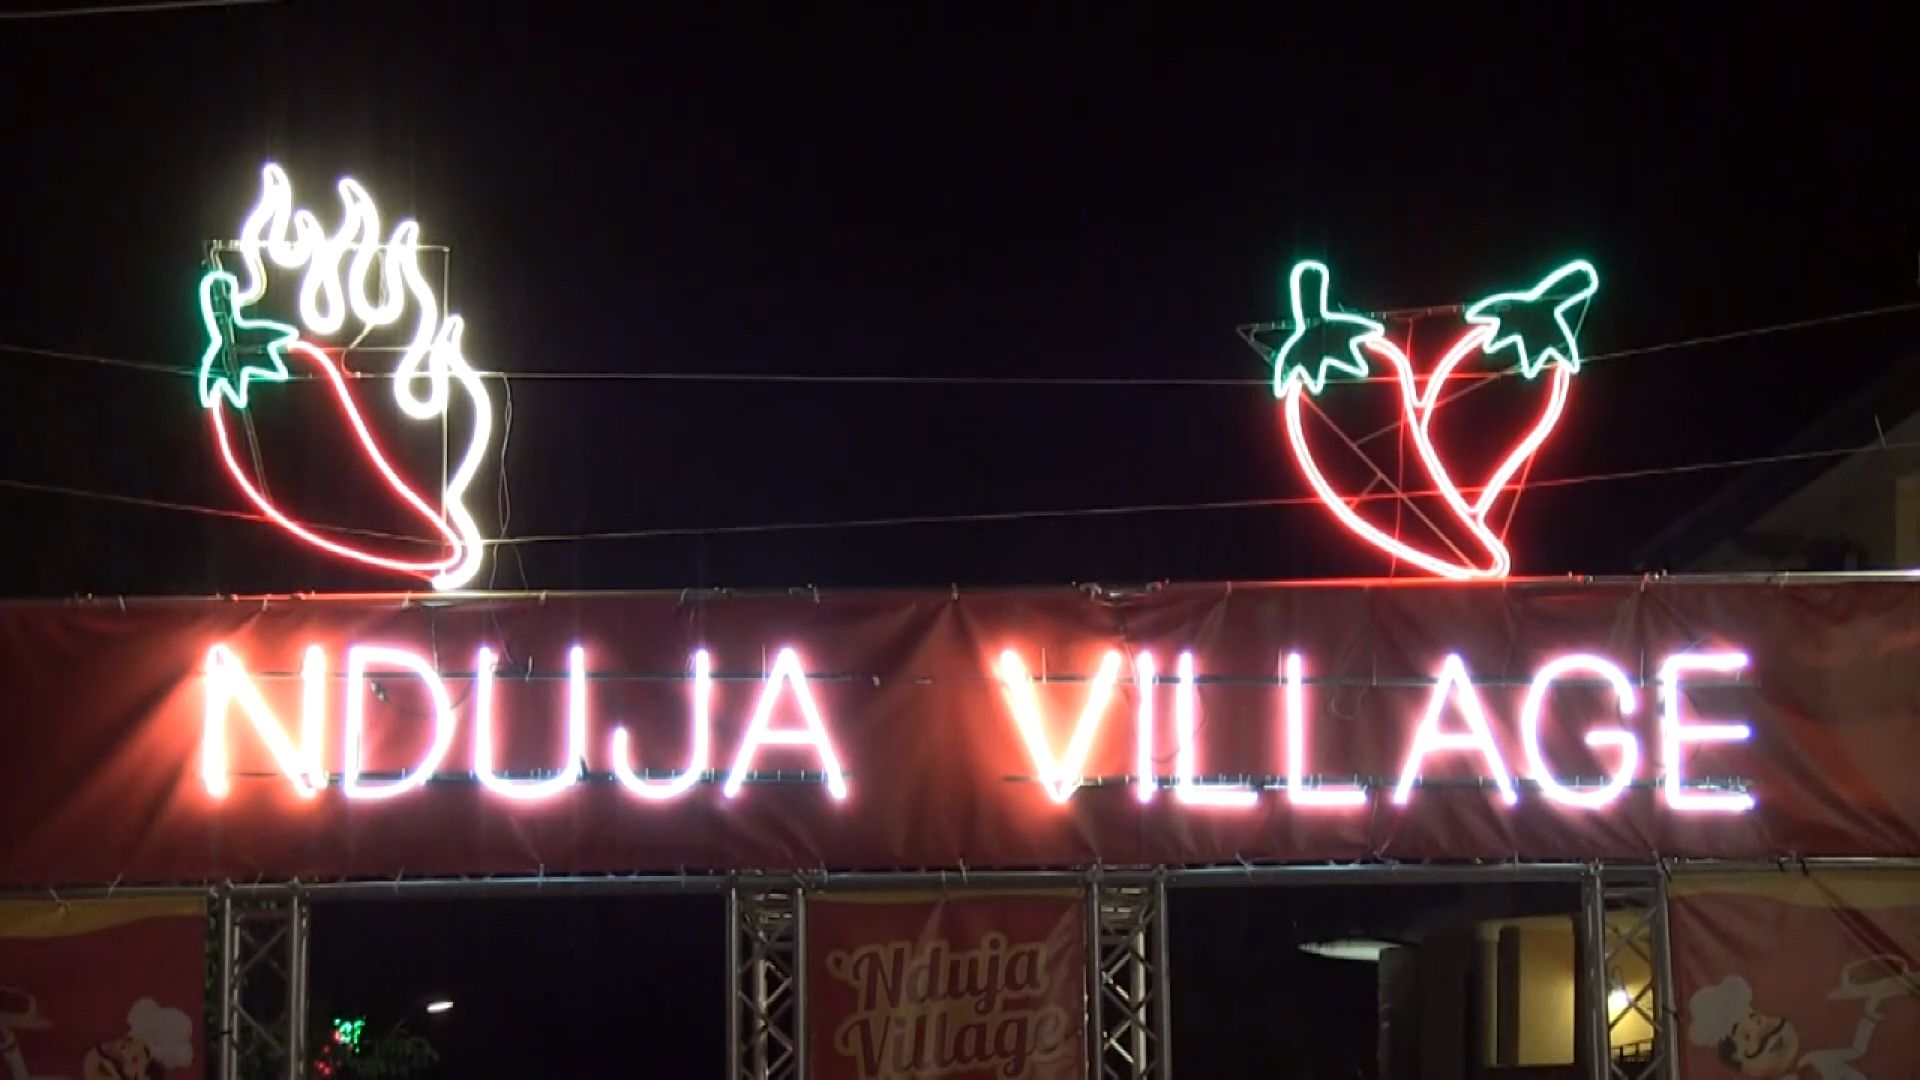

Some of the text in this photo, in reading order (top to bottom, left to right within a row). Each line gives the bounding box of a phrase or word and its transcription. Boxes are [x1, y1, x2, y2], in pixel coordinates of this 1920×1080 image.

[200, 643, 1757, 811] NDUJA VILLAGE
[842, 1009, 1062, 1078] Village
